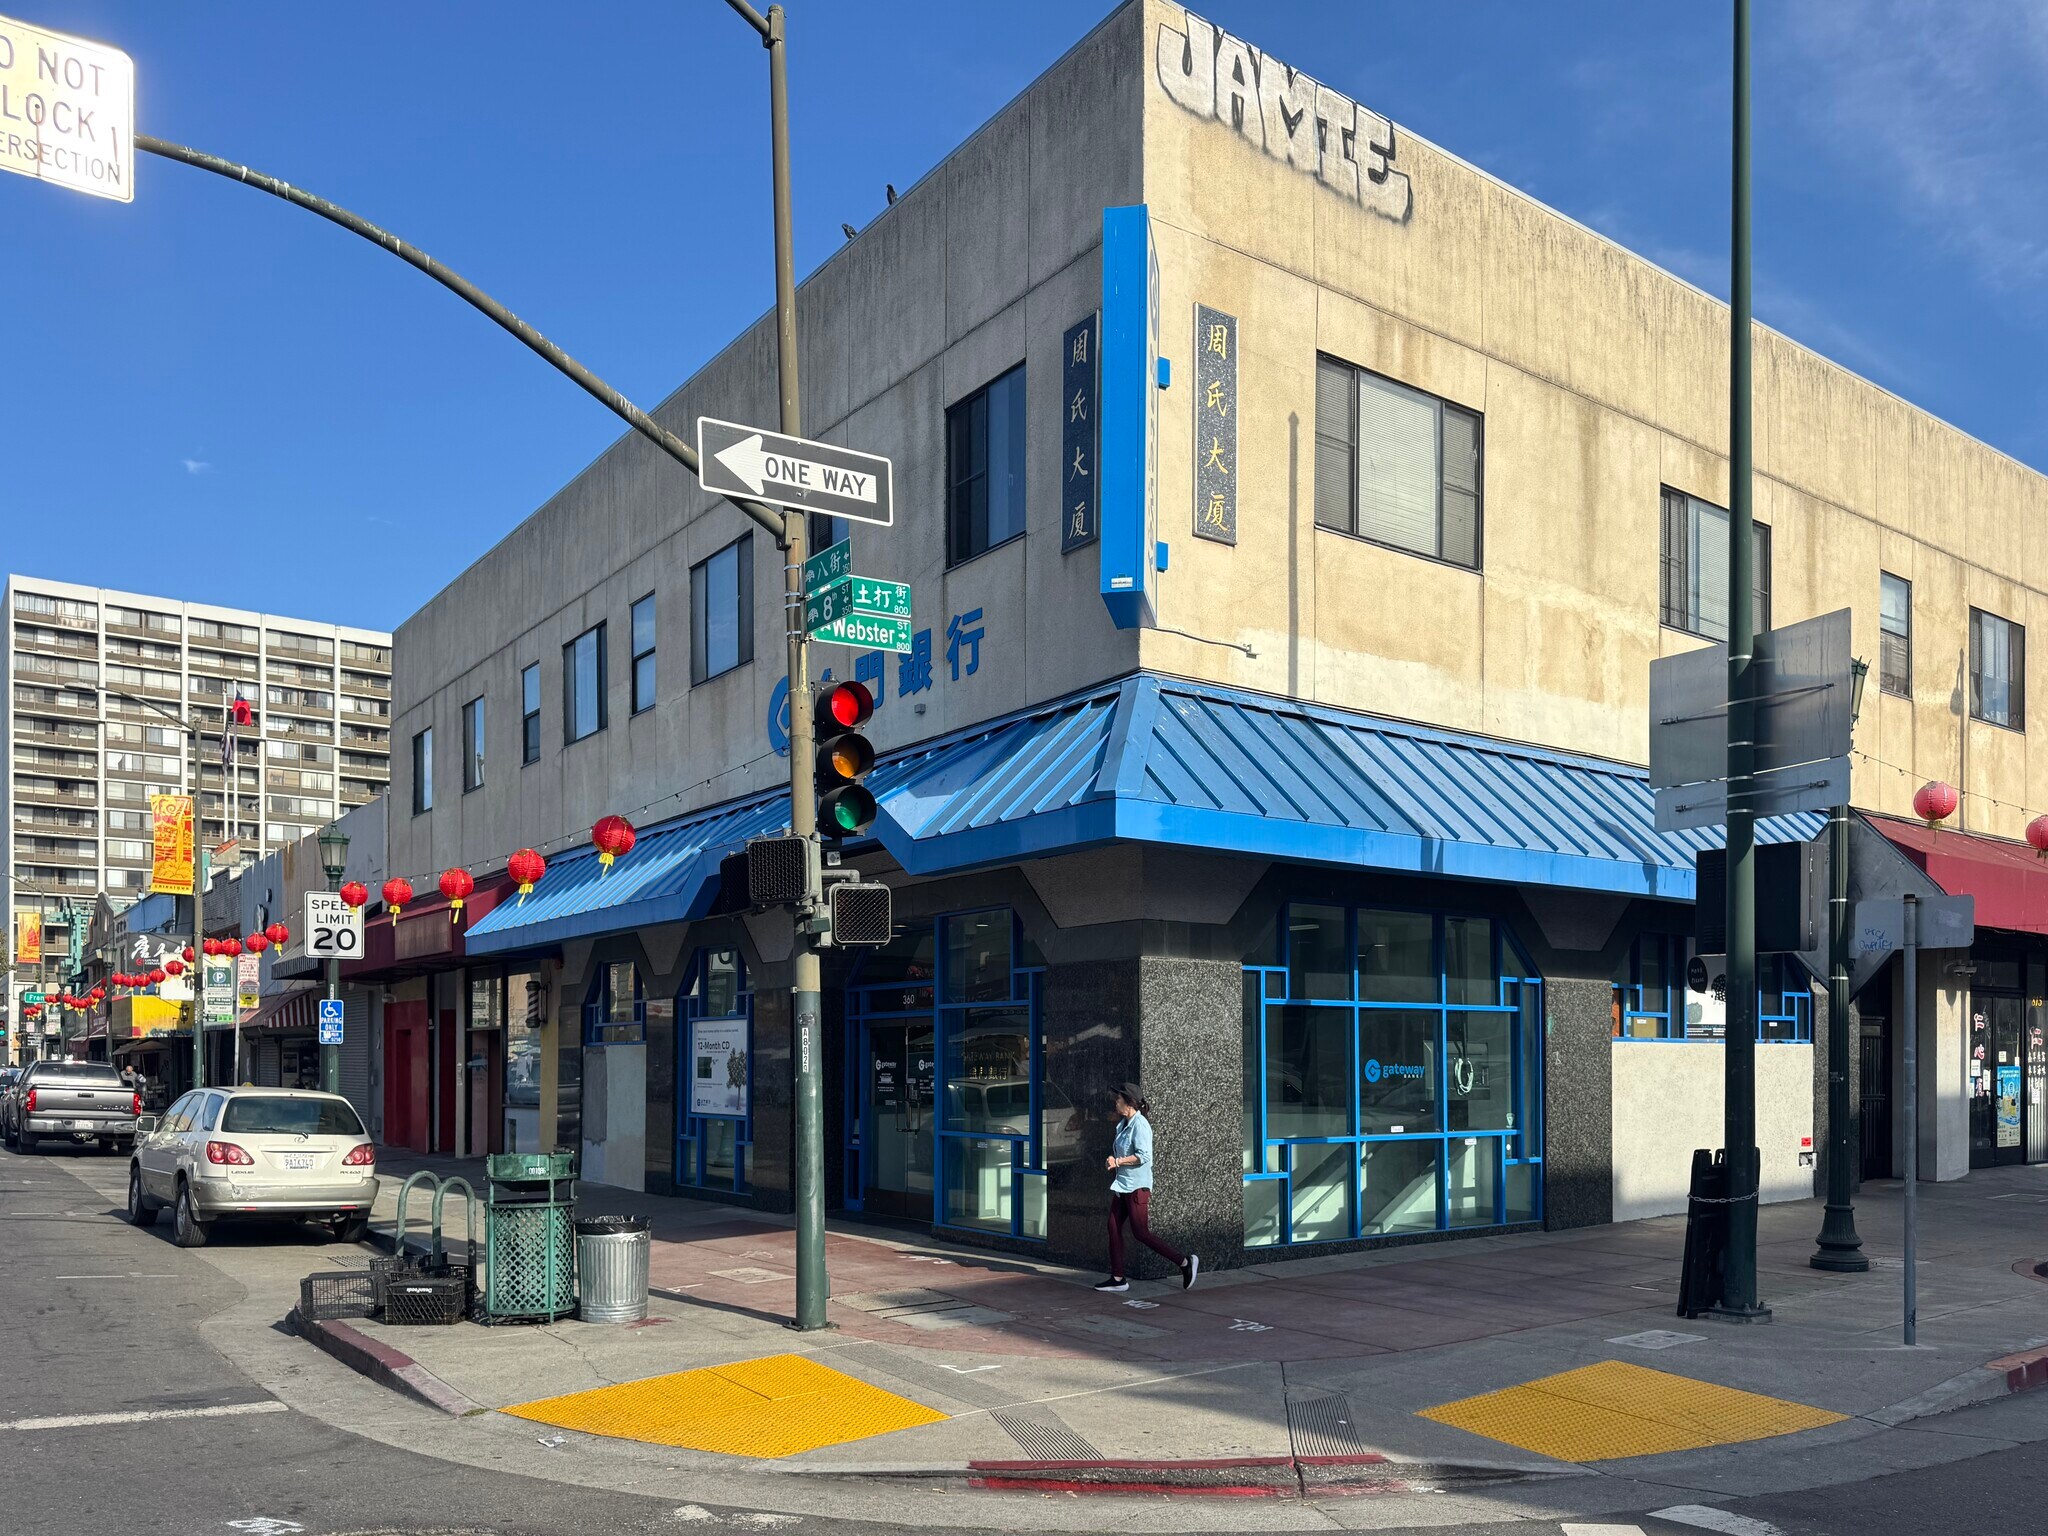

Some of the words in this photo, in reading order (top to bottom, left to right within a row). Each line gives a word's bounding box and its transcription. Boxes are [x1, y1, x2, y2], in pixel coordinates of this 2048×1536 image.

[38, 46, 105, 97] NOT
[2, 84, 96, 142] LOCK
[0, 131, 121, 186] RSECTION
[765, 456, 812, 486] ONE
[822, 468, 867, 496] WAY
[841, 583, 851, 595] ST
[841, 604, 853, 616] 350
[894, 606, 909, 615] 800
[833, 618, 895, 644] Webster
[897, 621, 909, 631] ST
[896, 642, 910, 651] 800
[821, 607, 985, 711] 門銀行
[312, 899, 350, 911] SPEE
[316, 914, 353, 925] LIMIT
[314, 927, 356, 951] 20
[902, 994, 915, 1004] 360
[697, 1042, 721, 1051] 12-Month
[722, 1041, 730, 1050] CD
[995, 1051, 1015, 1060] BANK
[1383, 1063, 1425, 1078] gateway
